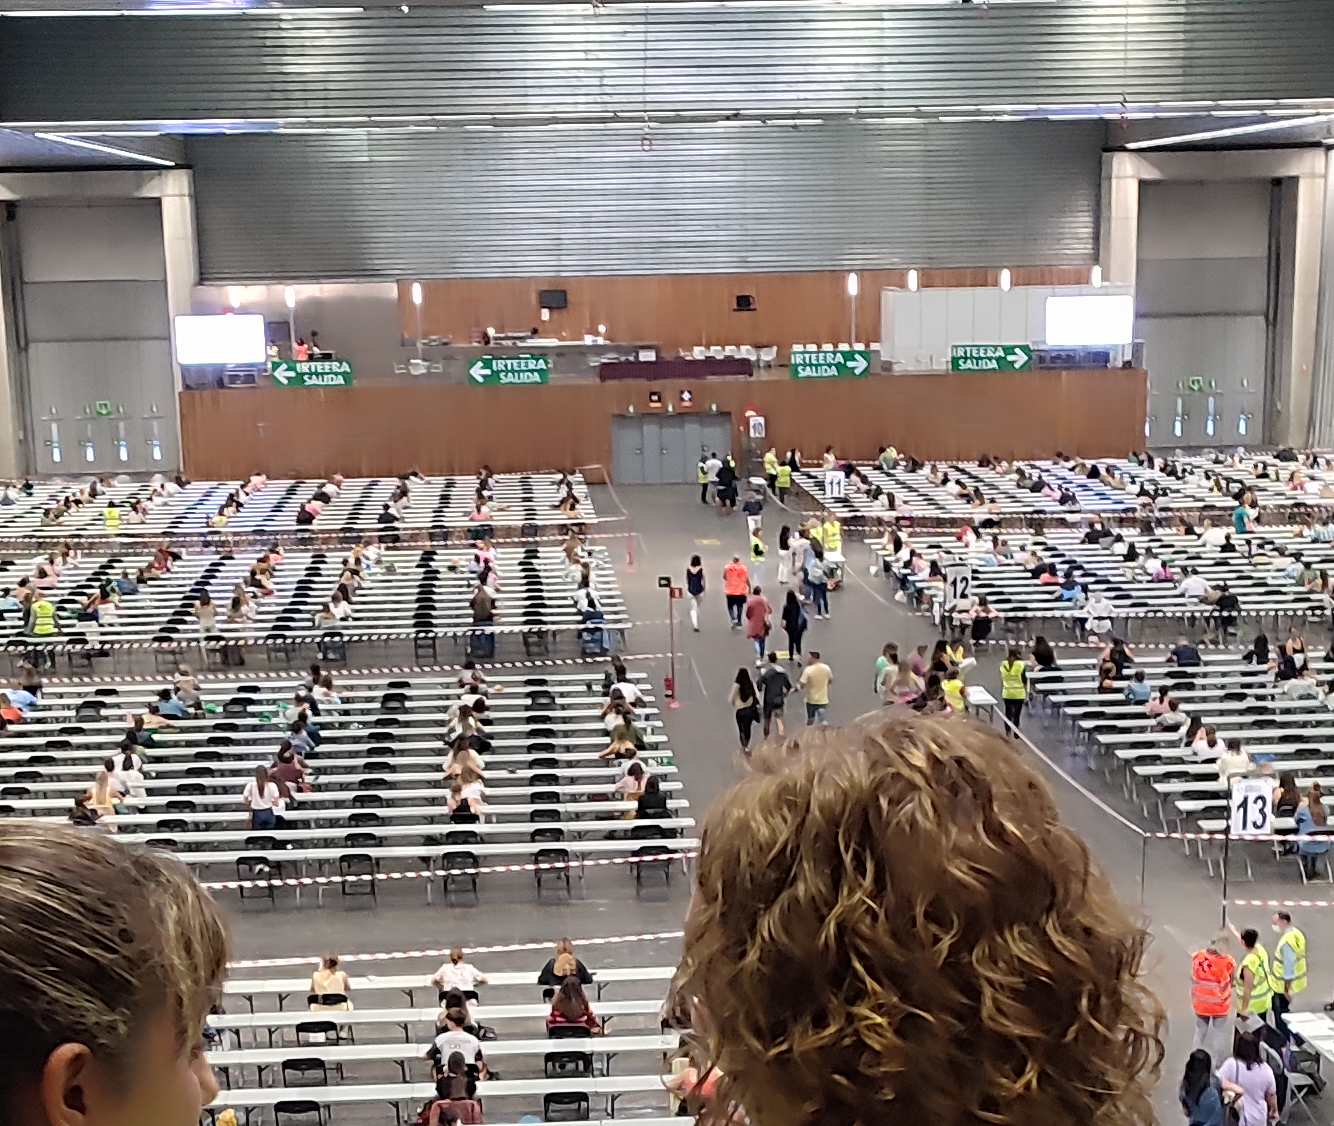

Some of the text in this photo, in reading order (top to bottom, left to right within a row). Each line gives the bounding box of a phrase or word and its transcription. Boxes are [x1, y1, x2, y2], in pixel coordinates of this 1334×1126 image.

[790, 352, 845, 364] IRTEERA
[952, 346, 1005, 358] IRTEERA
[296, 361, 351, 373] IRTEERA
[492, 359, 547, 371] IRTEERA
[828, 477, 842, 495] 11
[949, 575, 969, 599] 12
[1236, 794, 1267, 830] 13
